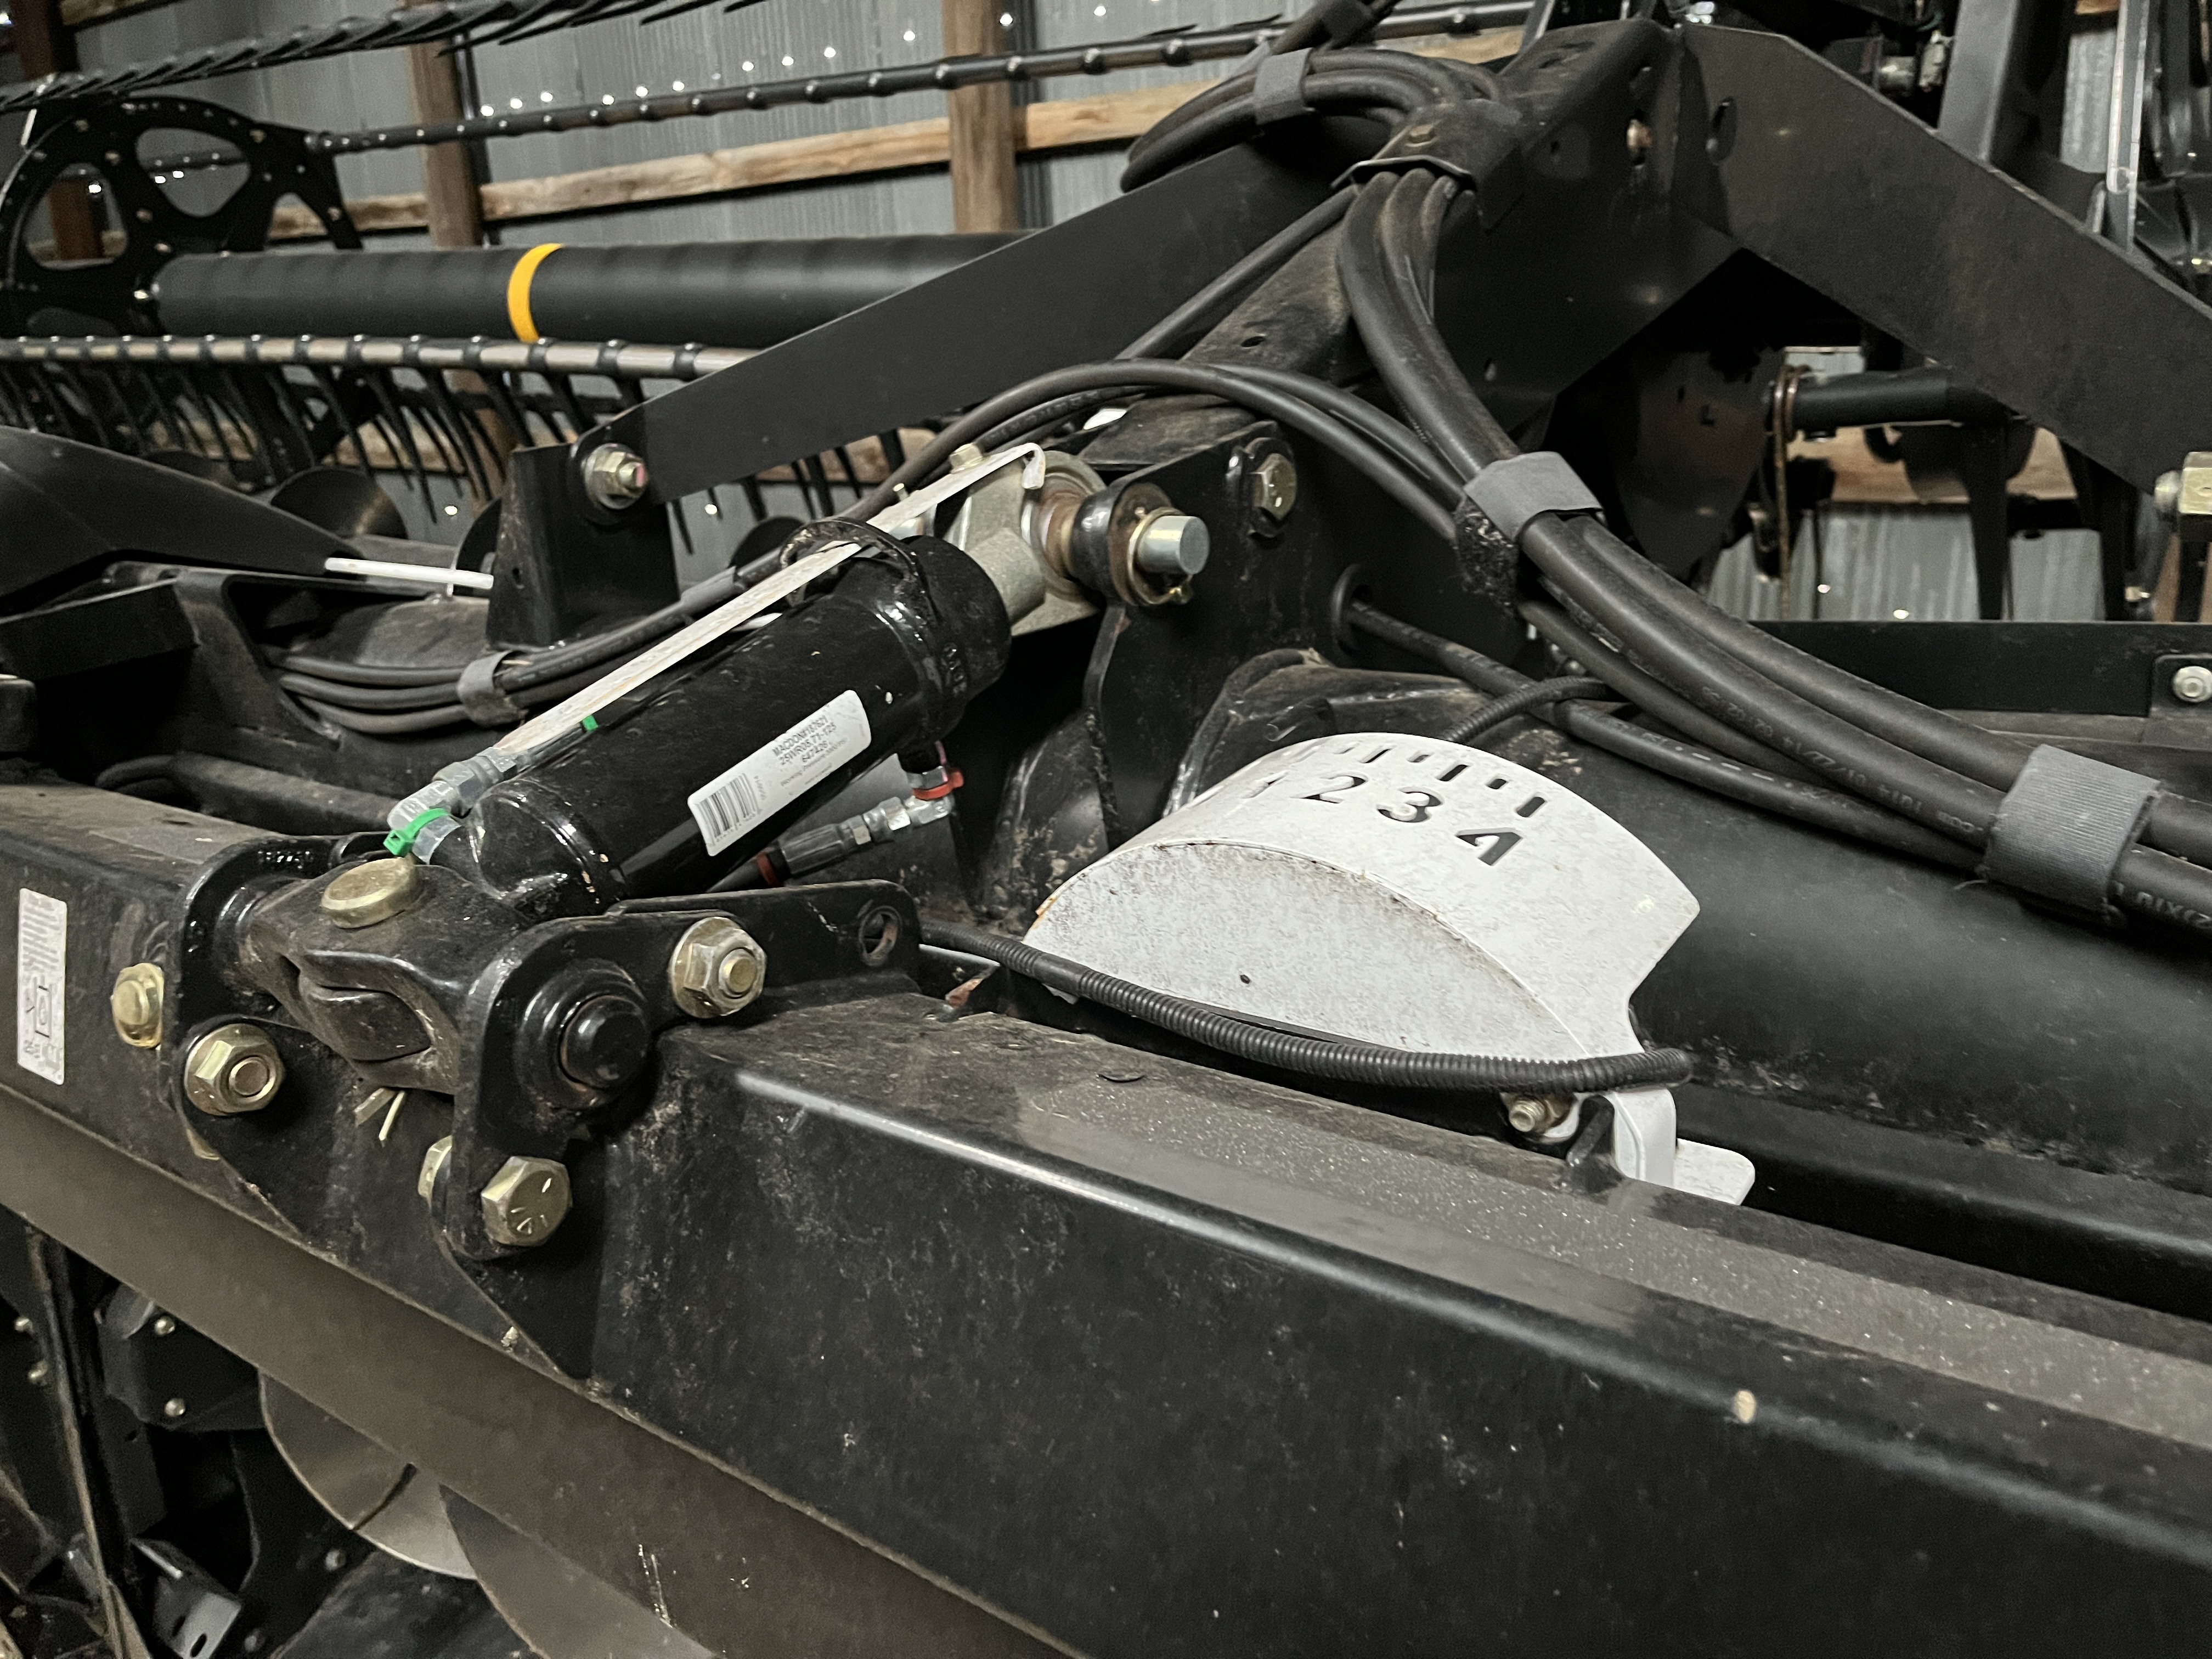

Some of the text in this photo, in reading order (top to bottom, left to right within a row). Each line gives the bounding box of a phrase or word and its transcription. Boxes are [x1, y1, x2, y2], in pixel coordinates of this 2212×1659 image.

[1289, 770, 1370, 804] 2
[1375, 786, 1445, 823] 3
[1453, 827, 1523, 866] 4
